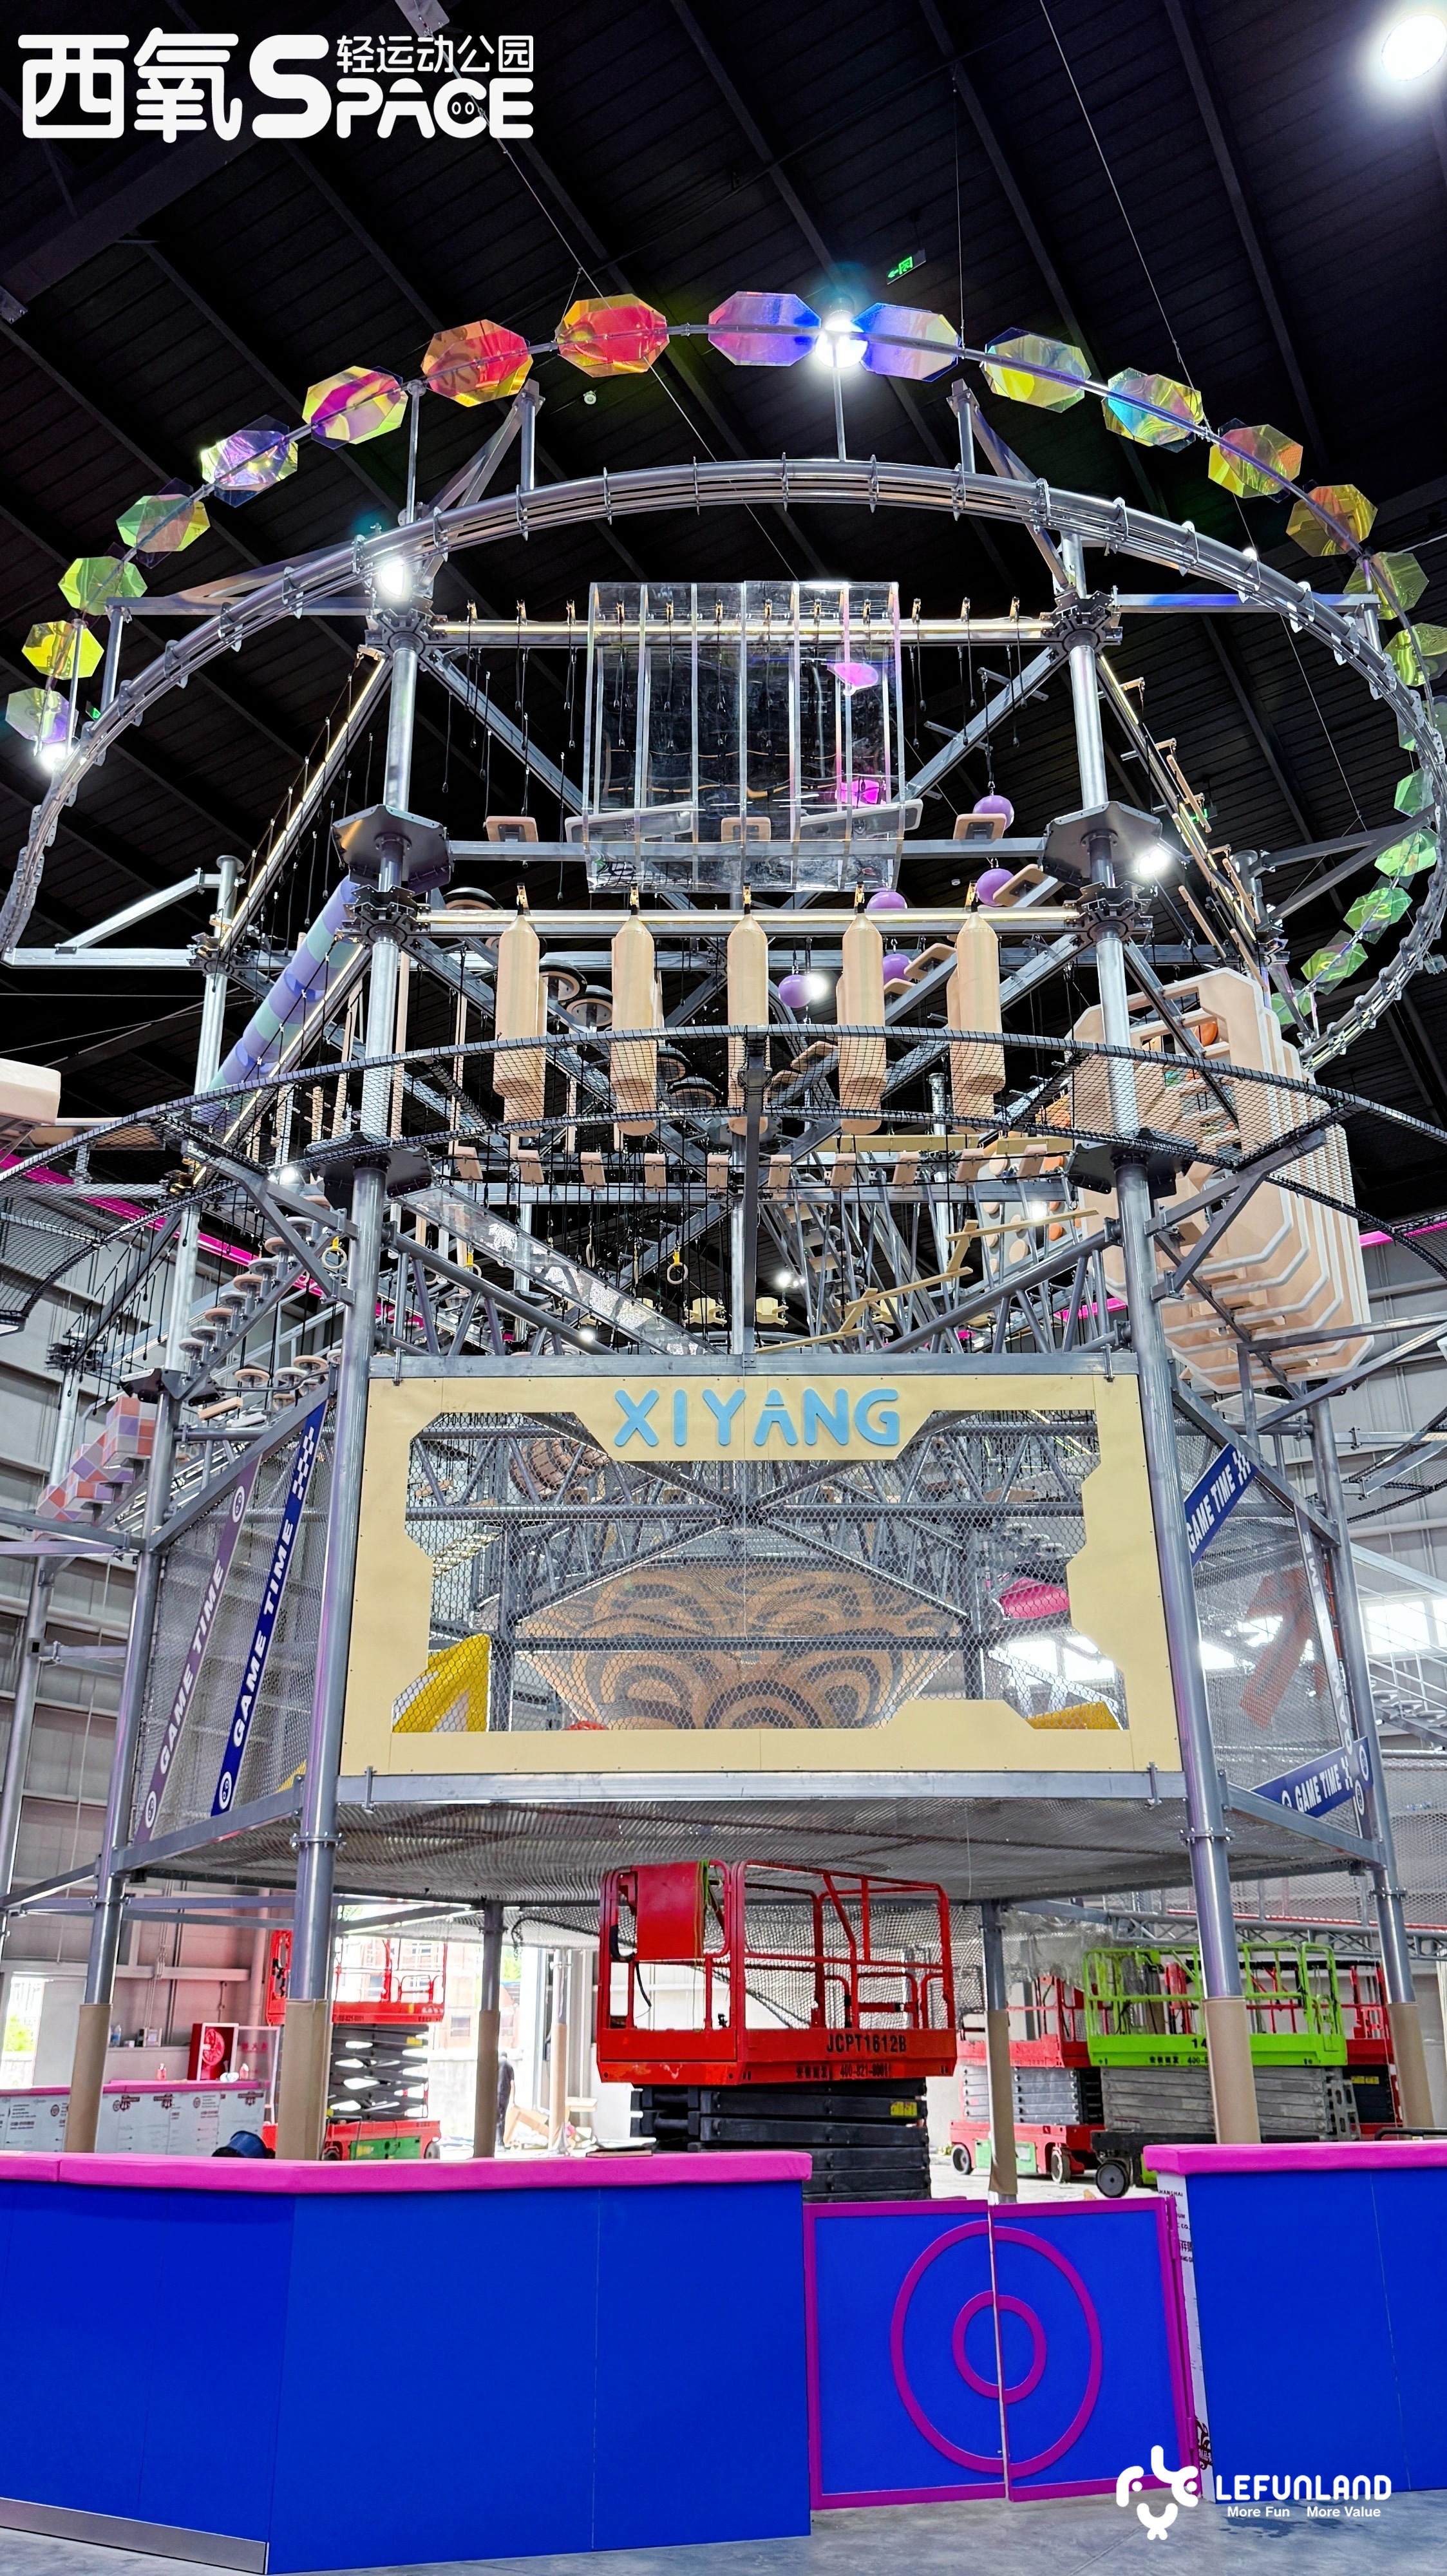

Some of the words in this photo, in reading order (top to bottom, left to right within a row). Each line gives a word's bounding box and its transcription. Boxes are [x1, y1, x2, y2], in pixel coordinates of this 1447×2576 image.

[614, 1388, 900, 1446] XIYANG
[1186, 1494, 1215, 1554] GAME
[1210, 1464, 1236, 1513] TIME
[160, 1663, 194, 1775] GAME
[193, 1558, 224, 1654] TIME
[233, 1629, 267, 1748] GAME
[263, 1519, 294, 1615] TIME
[1294, 1776, 1322, 1813] GAME
[1319, 1764, 1343, 1799] TIME
[826, 2033, 907, 2053] JCPT1612B
